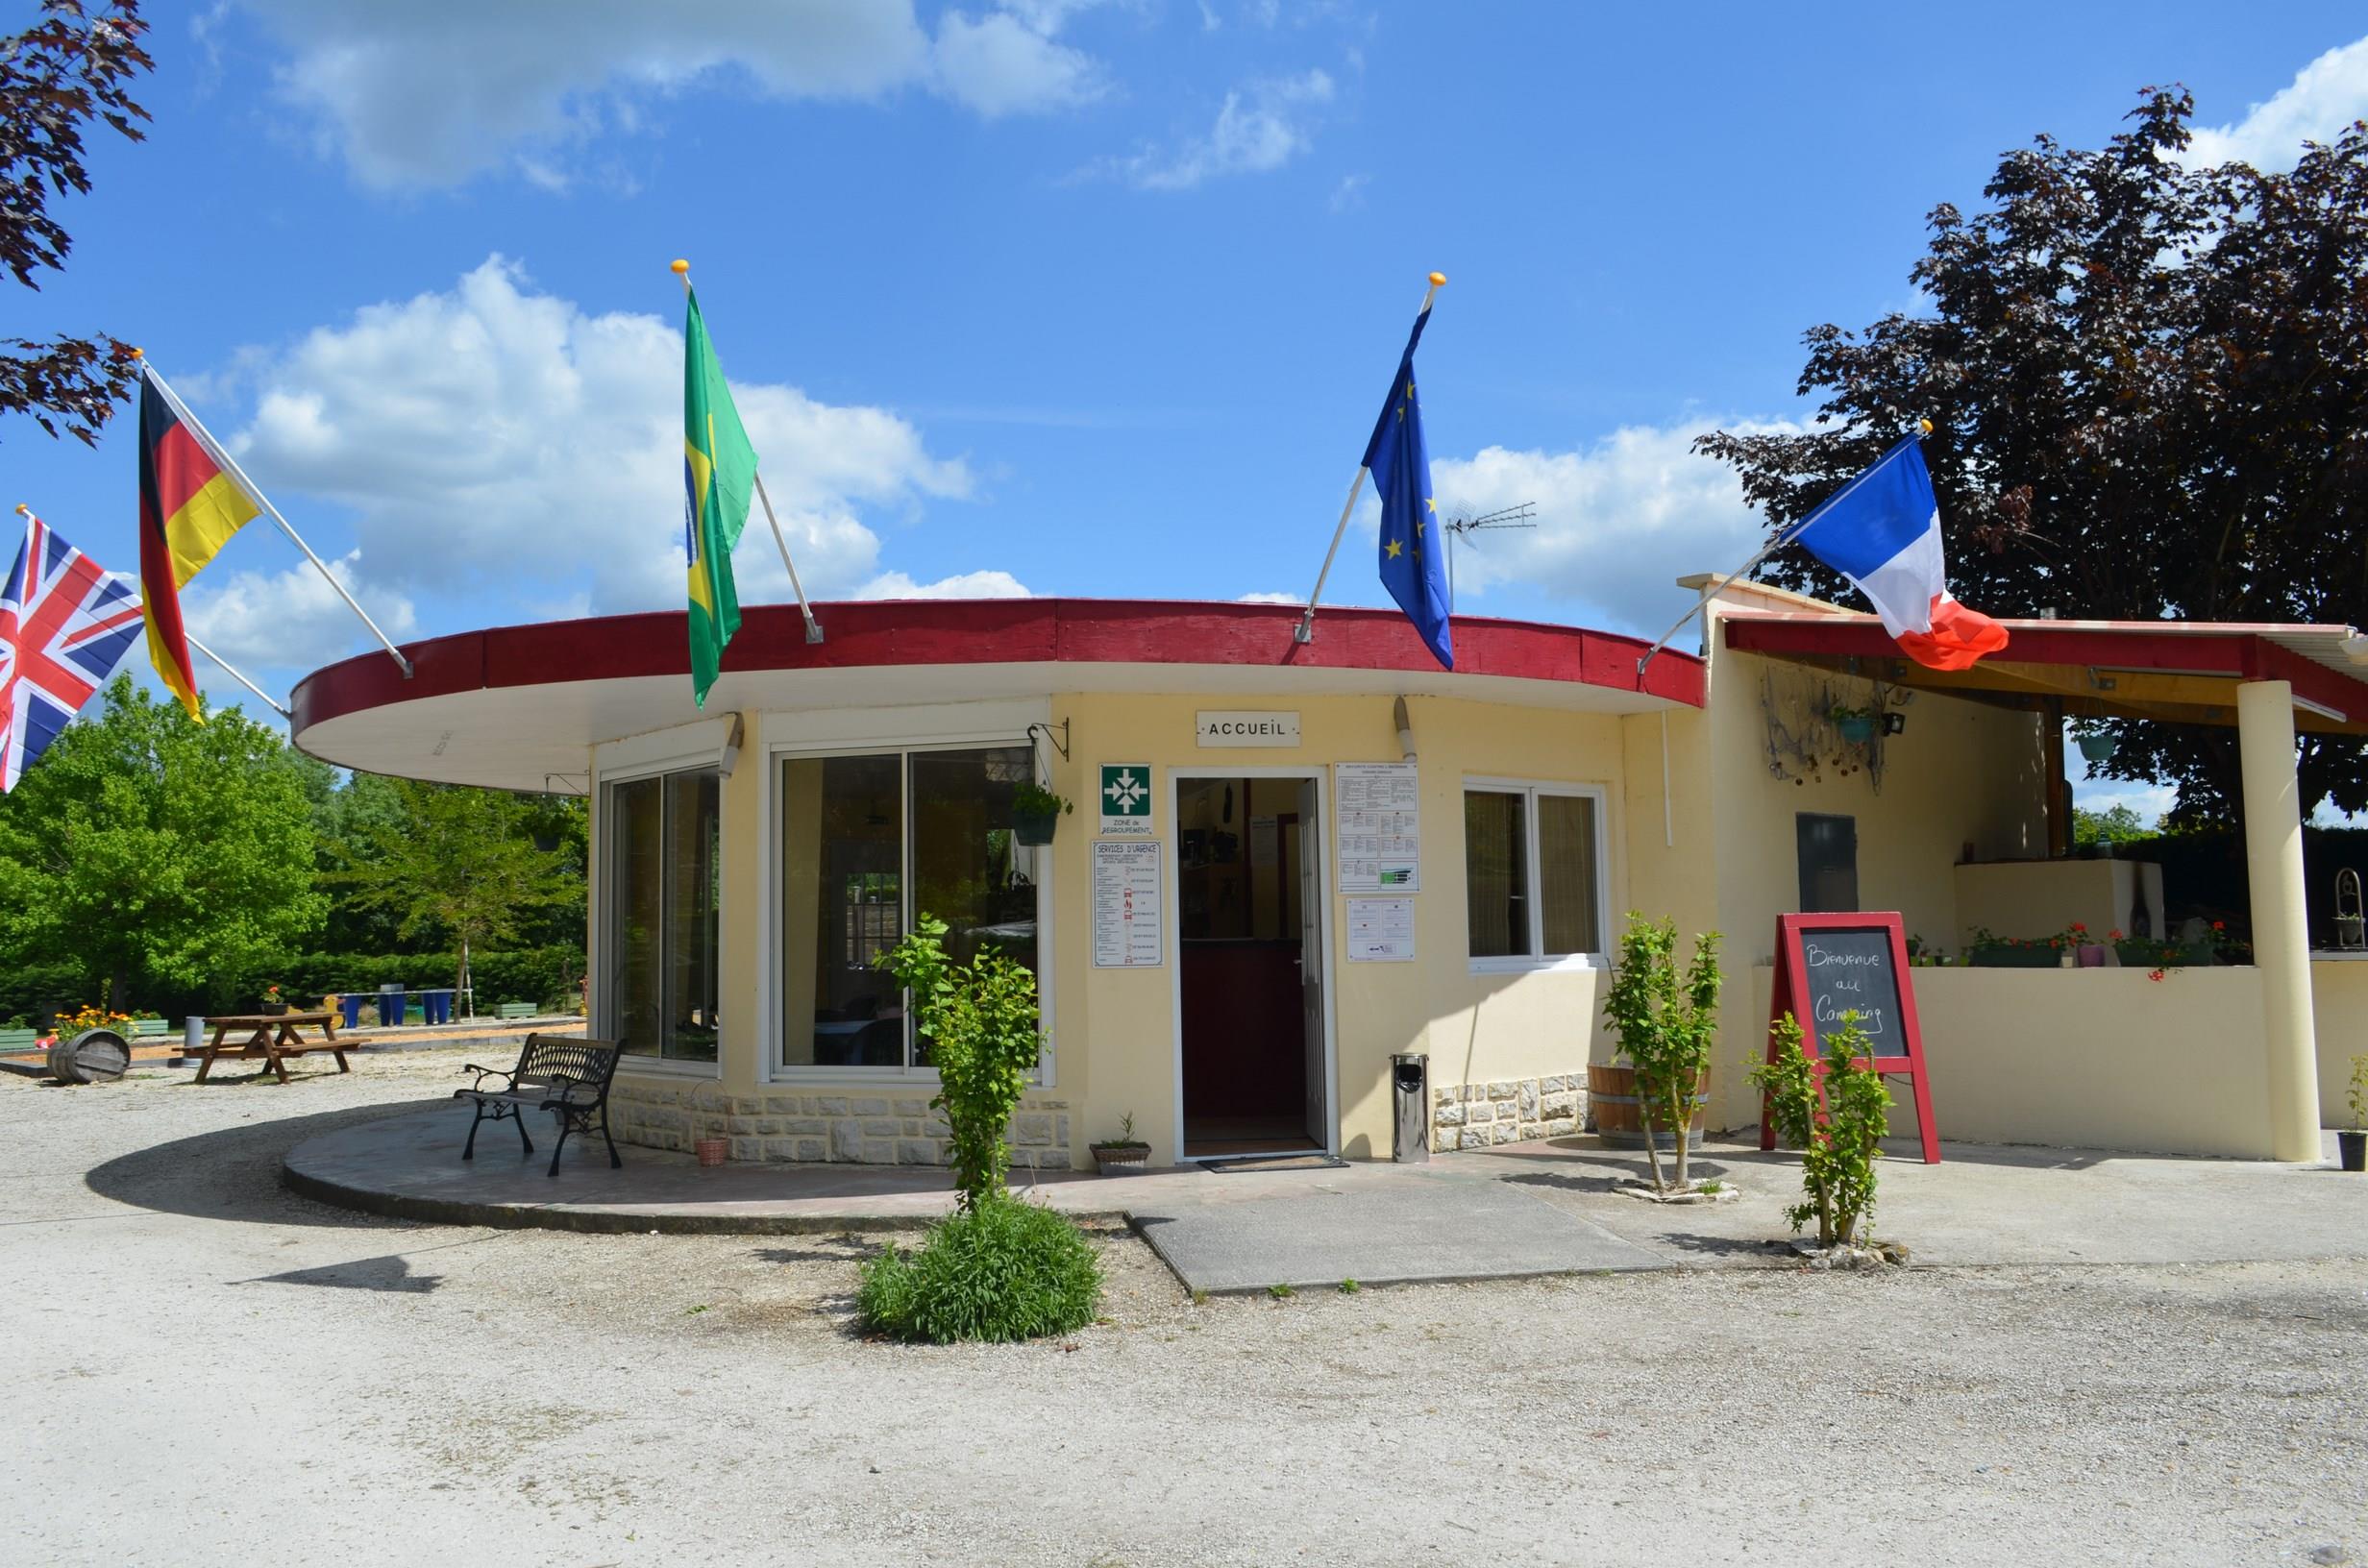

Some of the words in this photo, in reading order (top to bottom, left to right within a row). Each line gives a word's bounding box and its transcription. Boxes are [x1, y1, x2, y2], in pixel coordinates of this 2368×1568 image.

[1098, 845, 1124, 853] SERVICES
[1807, 943, 1880, 967] Bienvenue
[1836, 979, 1862, 992] au
